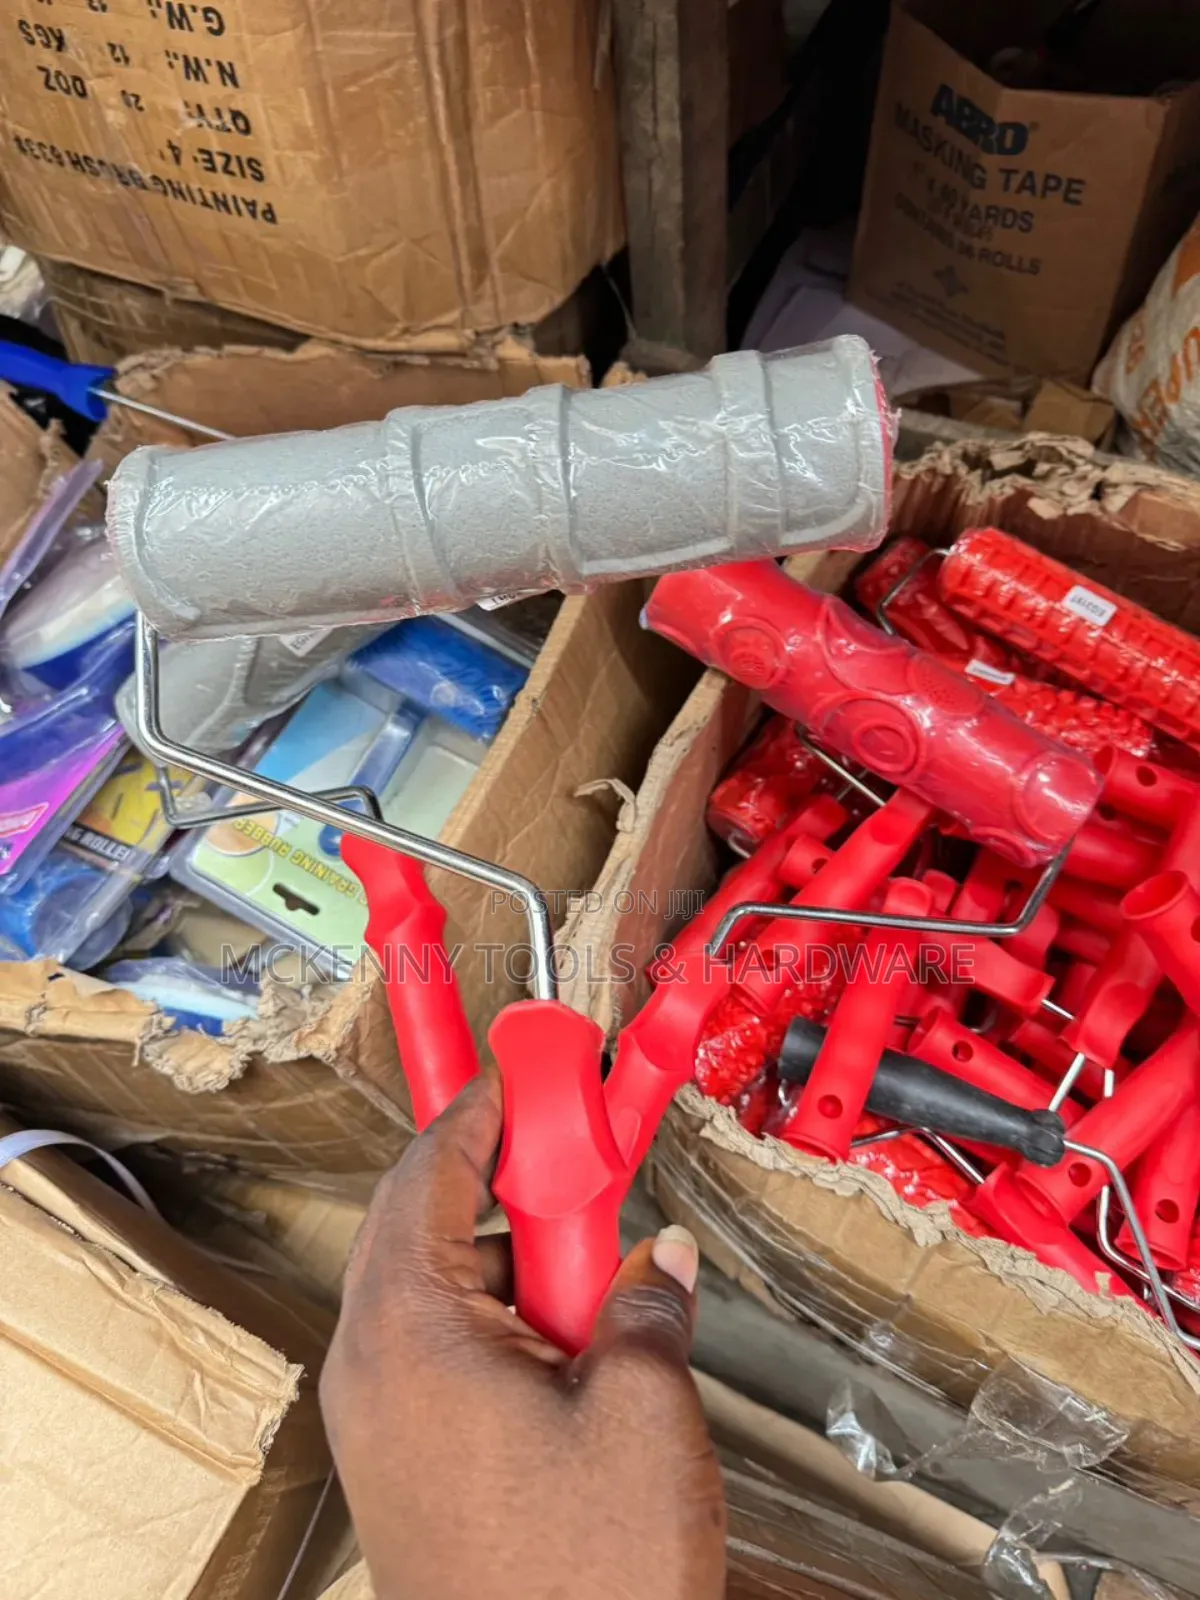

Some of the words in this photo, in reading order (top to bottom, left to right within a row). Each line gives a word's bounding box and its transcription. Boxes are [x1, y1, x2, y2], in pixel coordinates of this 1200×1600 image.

[17, 19, 66, 52] KGS
[107, 41, 131, 66] 12
[930, 84, 1028, 156] ABRO
[894, 101, 988, 190] MASKING
[998, 168, 1086, 206] TAPE
[150, 174, 278, 224] PAINTING
[978, 248, 1042, 275] ROLLS
[233, 816, 288, 858] RUBBER
[289, 846, 360, 900] GRAINING
